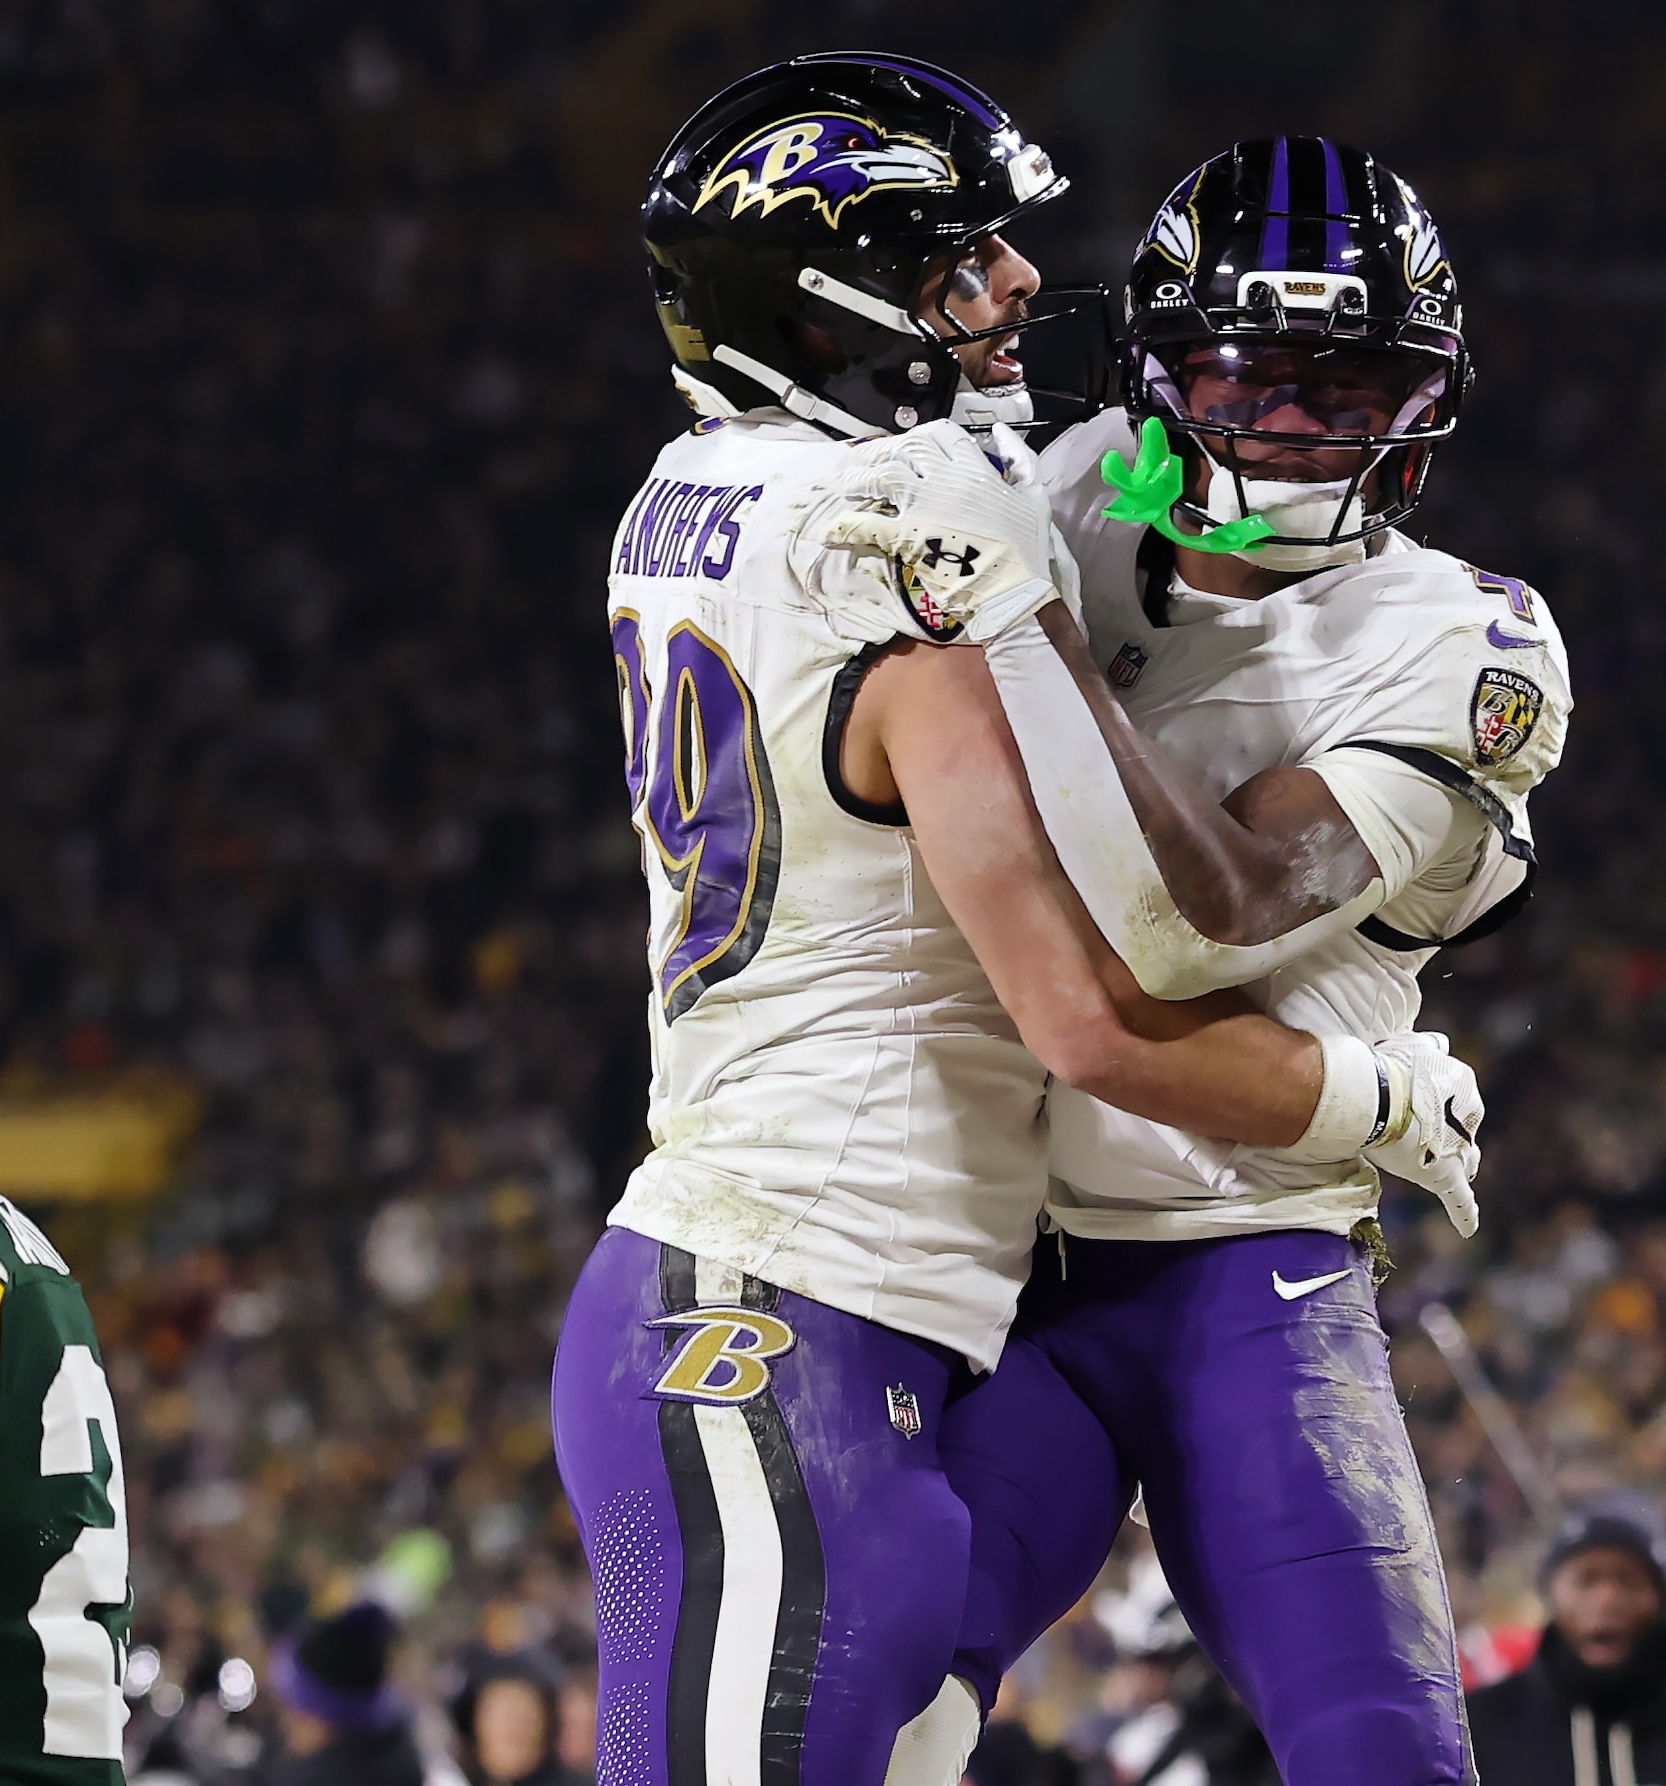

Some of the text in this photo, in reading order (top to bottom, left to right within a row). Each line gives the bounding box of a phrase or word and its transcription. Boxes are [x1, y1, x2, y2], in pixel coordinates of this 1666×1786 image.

[737, 122, 825, 185] B
[1150, 298, 1189, 309] OAKLEY
[1485, 671, 1540, 702] RAVENS
[650, 1306, 795, 1402] B
